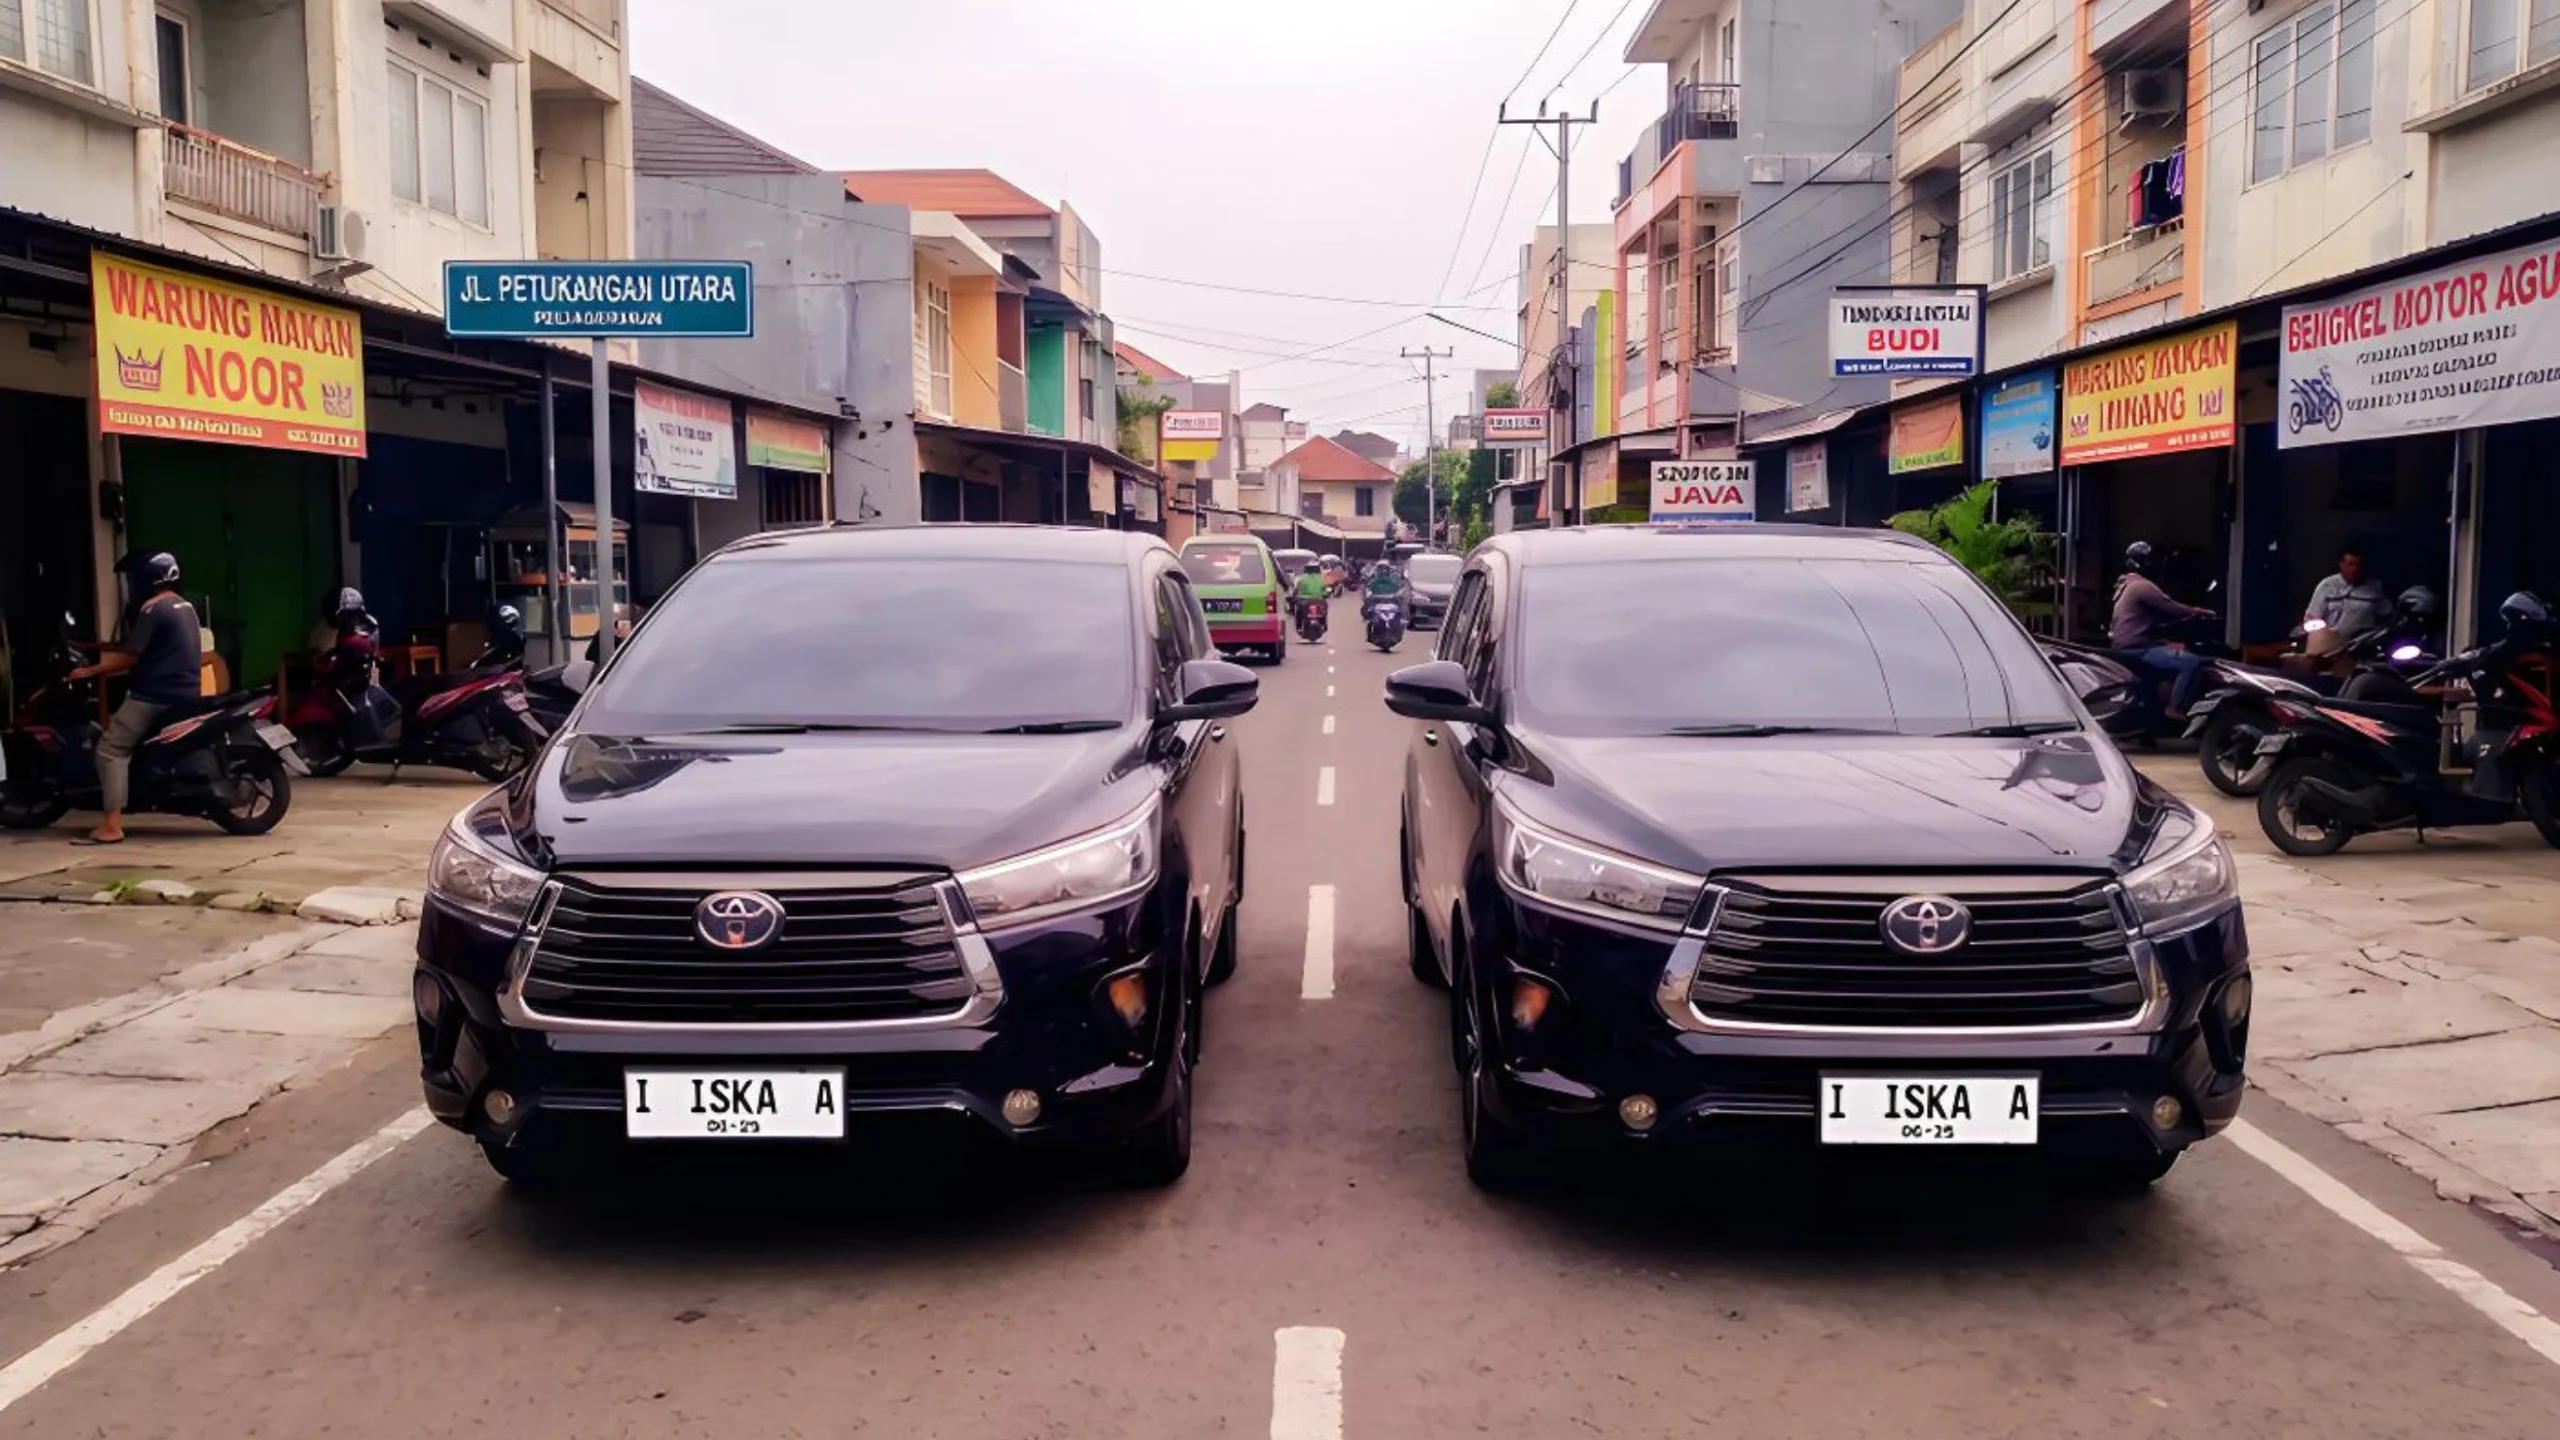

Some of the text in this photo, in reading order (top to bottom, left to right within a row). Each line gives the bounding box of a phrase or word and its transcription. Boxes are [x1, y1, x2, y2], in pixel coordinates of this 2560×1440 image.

[661, 275, 736, 302] UTARA
[107, 267, 354, 358] WARUNG MAKAN
[2287, 297, 2387, 353] BENGKEL
[2393, 271, 2488, 331] MOTOR
[1868, 328, 1939, 351] BUDI
[184, 344, 308, 411] NOOR
[1663, 485, 1744, 504] JAVA
[636, 1079, 835, 1115] I ISKA A
[1829, 1084, 2030, 1120] I ISKA A
